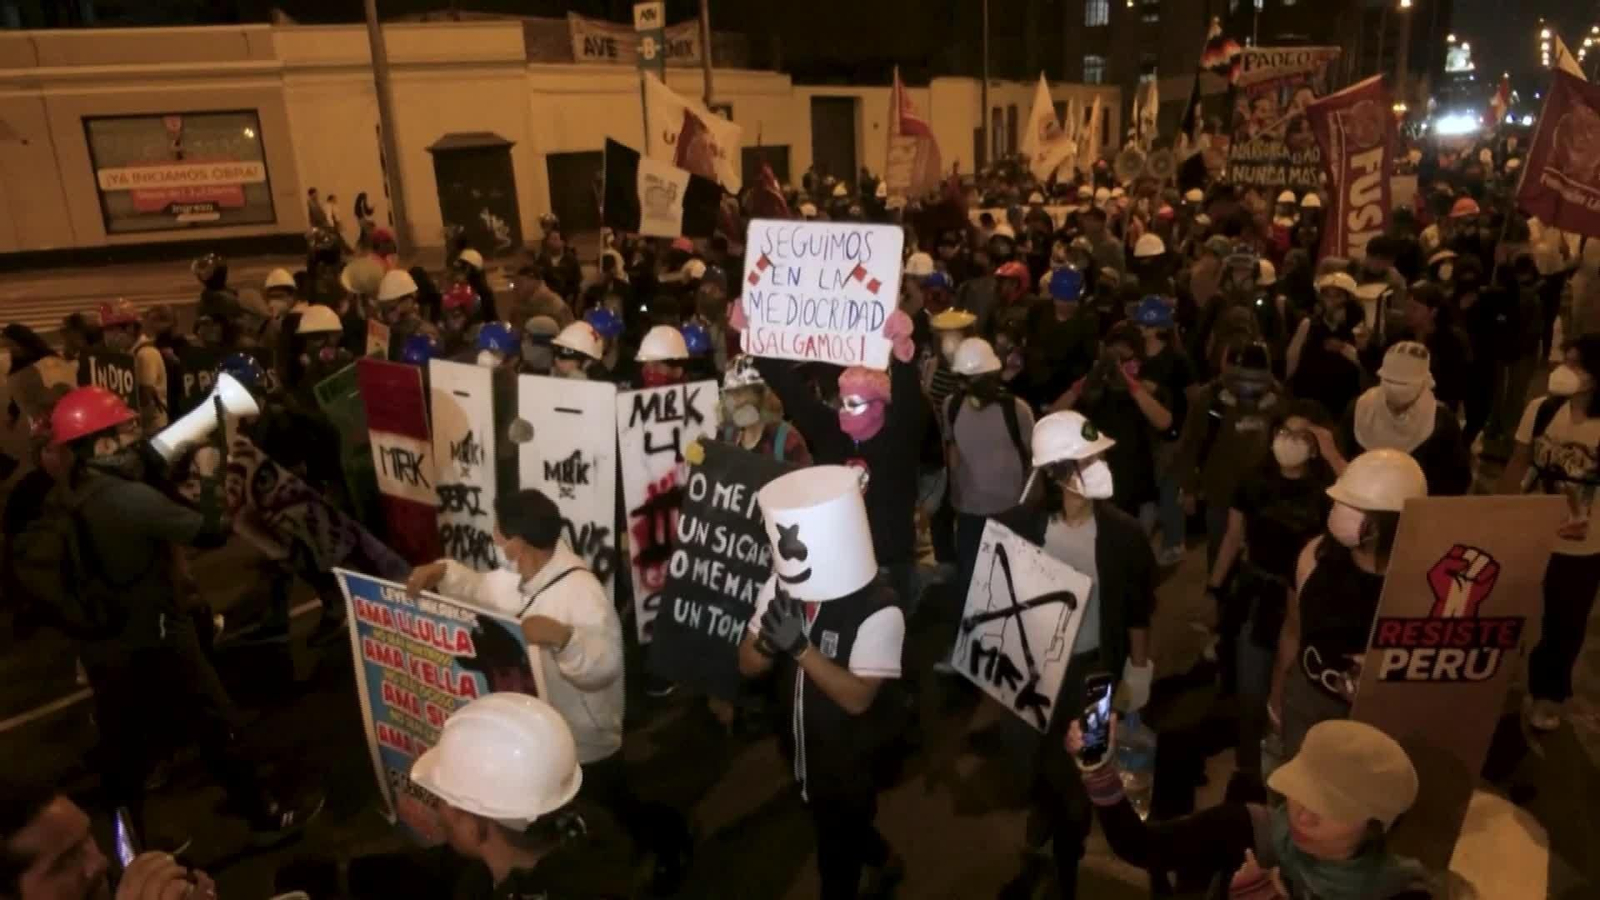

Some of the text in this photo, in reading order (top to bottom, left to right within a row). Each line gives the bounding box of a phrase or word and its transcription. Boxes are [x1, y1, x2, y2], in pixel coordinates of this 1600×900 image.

[132, 168, 209, 184] INICIAMOS
[761, 226, 874, 262] SEGUIMOS
[772, 263, 801, 287] EN
[750, 291, 885, 332] MEDIOCRIDAD
[379, 445, 431, 490] MRK
[689, 472, 707, 501] O
[712, 481, 746, 512] ME
[677, 514, 774, 568] UN SICAR
[669, 549, 689, 579] O
[724, 571, 767, 604] MAT
[354, 596, 397, 633] AMA
[394, 608, 477, 659] LLULLA
[673, 597, 746, 646] UN TOM
[1378, 620, 1518, 646] RESISTE
[363, 635, 405, 670] AMA
[407, 653, 479, 699] KELLA
[1378, 646, 1501, 681] PERÚ
[382, 680, 422, 720] AMA
